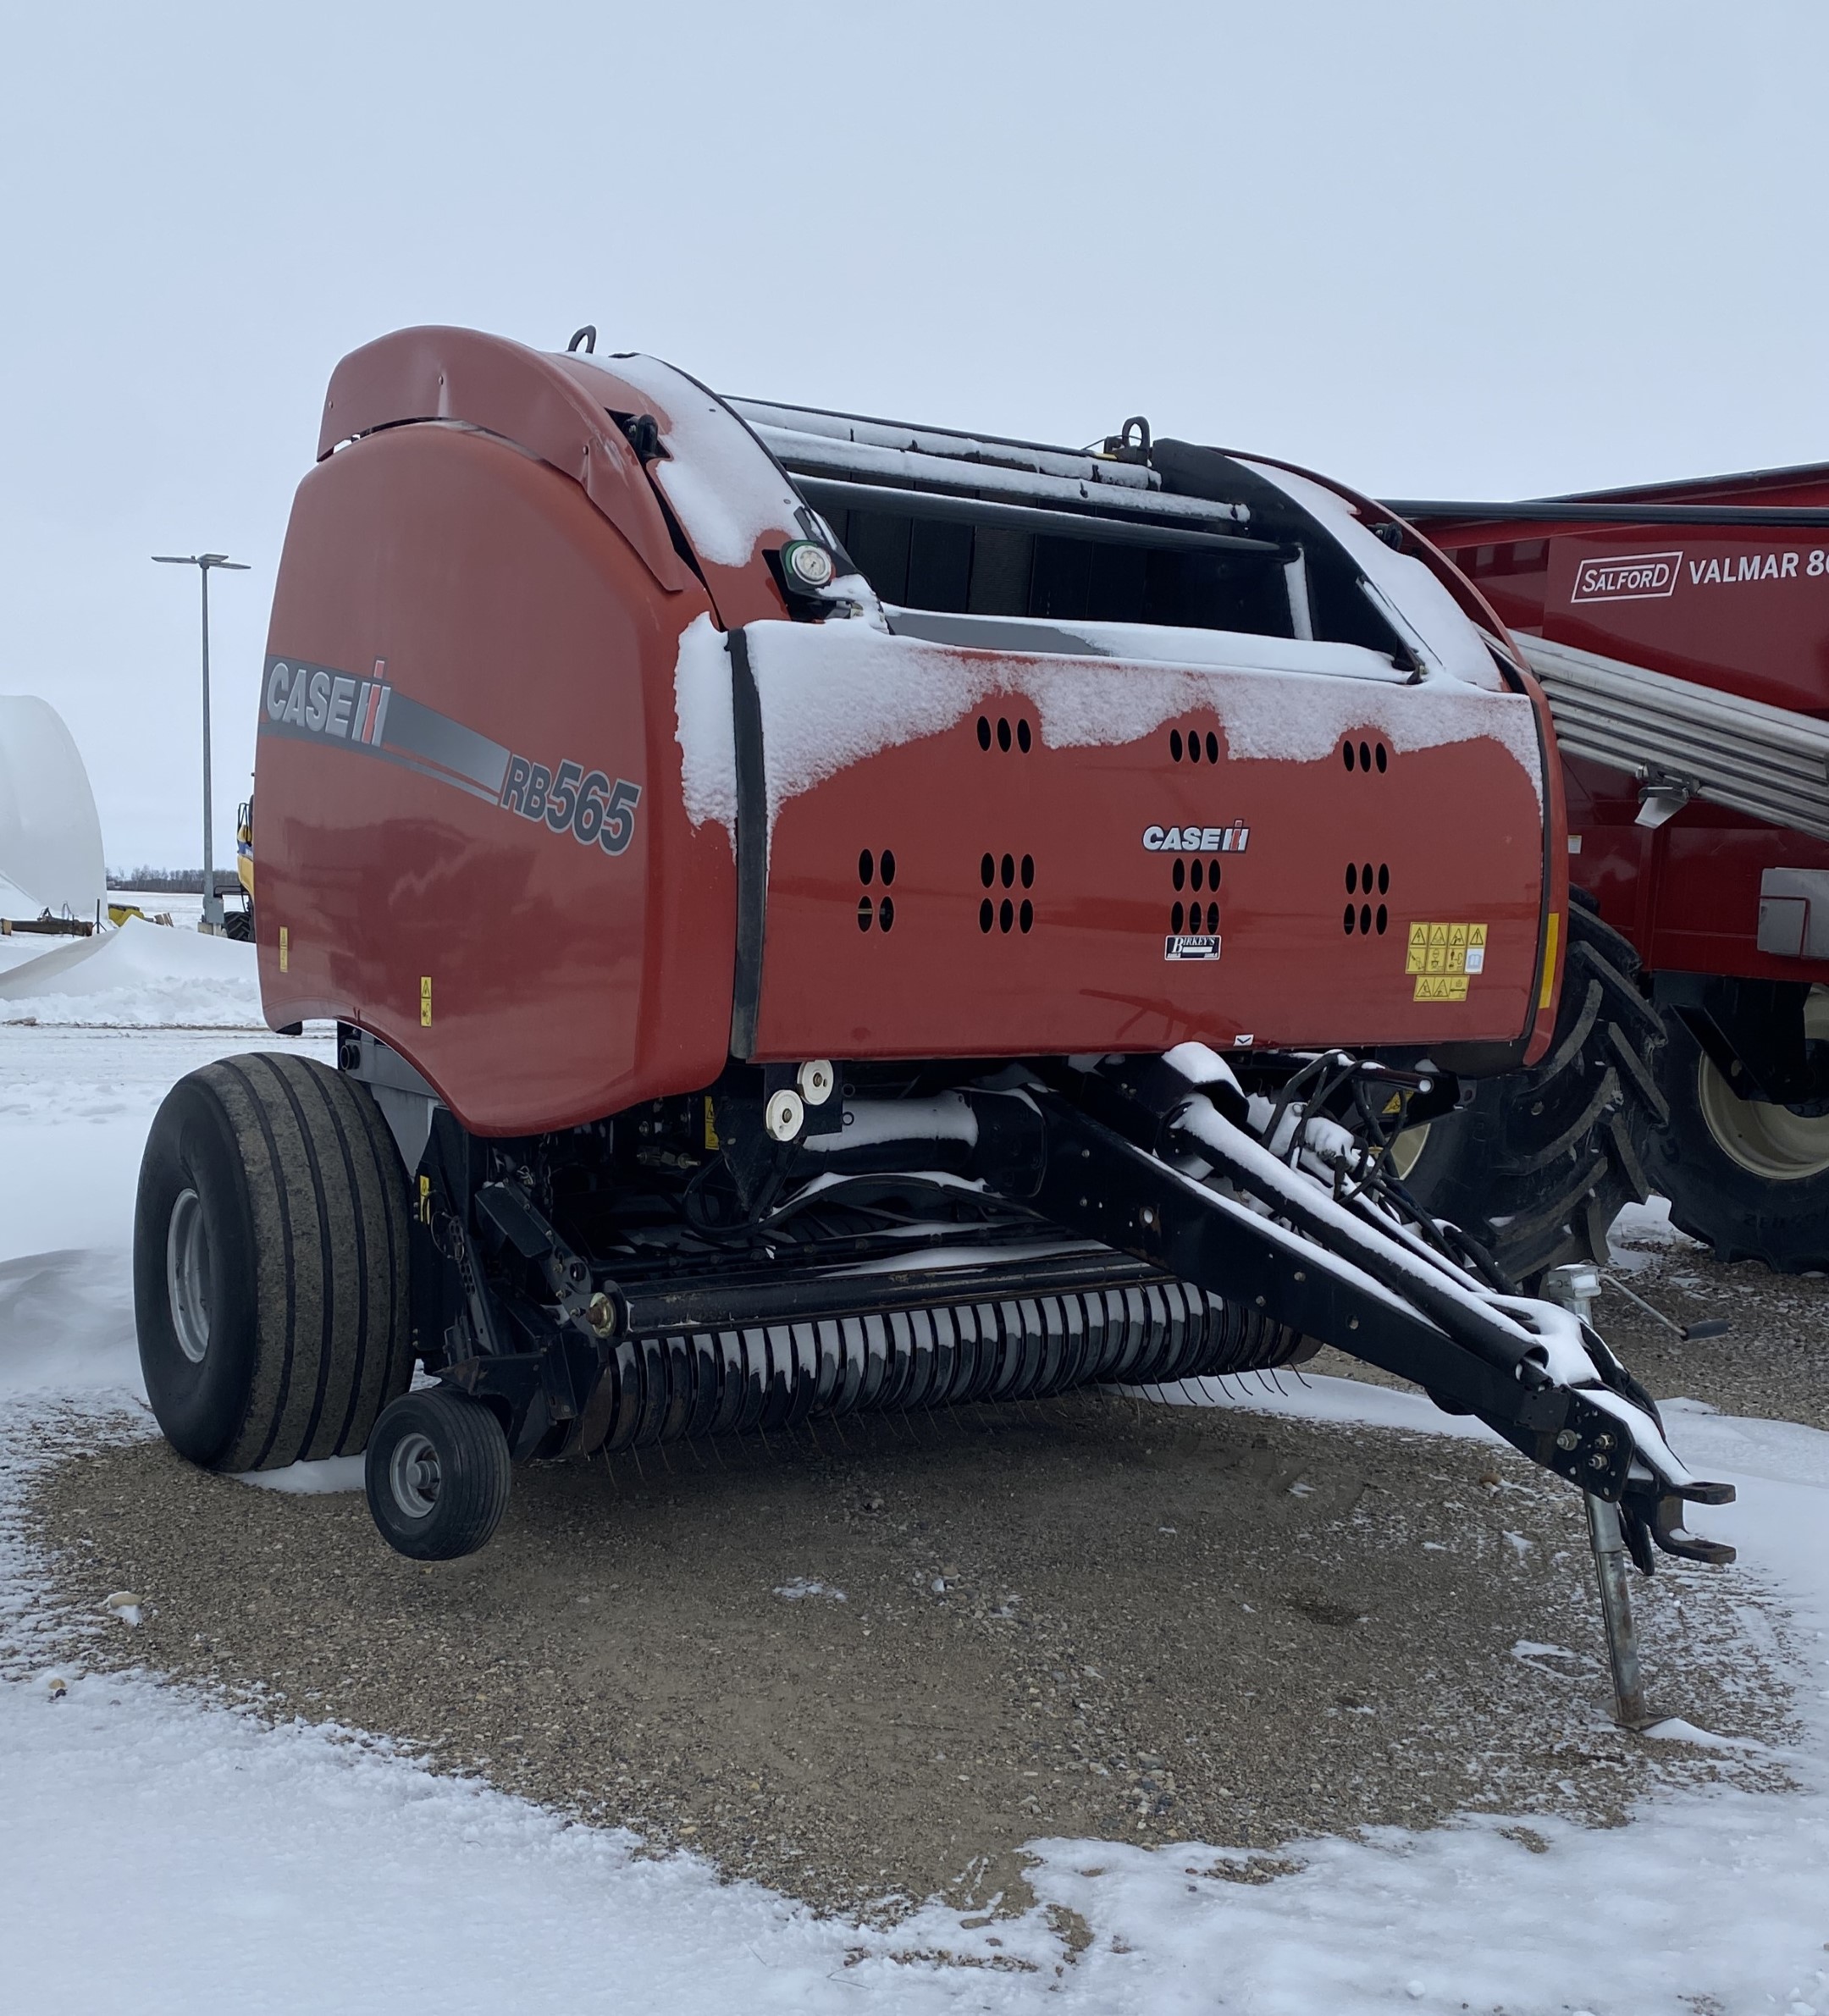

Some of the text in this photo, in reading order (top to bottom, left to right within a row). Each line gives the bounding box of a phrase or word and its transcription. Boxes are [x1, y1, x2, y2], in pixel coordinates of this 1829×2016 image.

[1582, 563, 1670, 593] SALFORD
[1688, 550, 1829, 585] VALMAR 8
[267, 662, 356, 738] CASE
[500, 754, 642, 856] RB565
[1142, 826, 1222, 851] CASE
